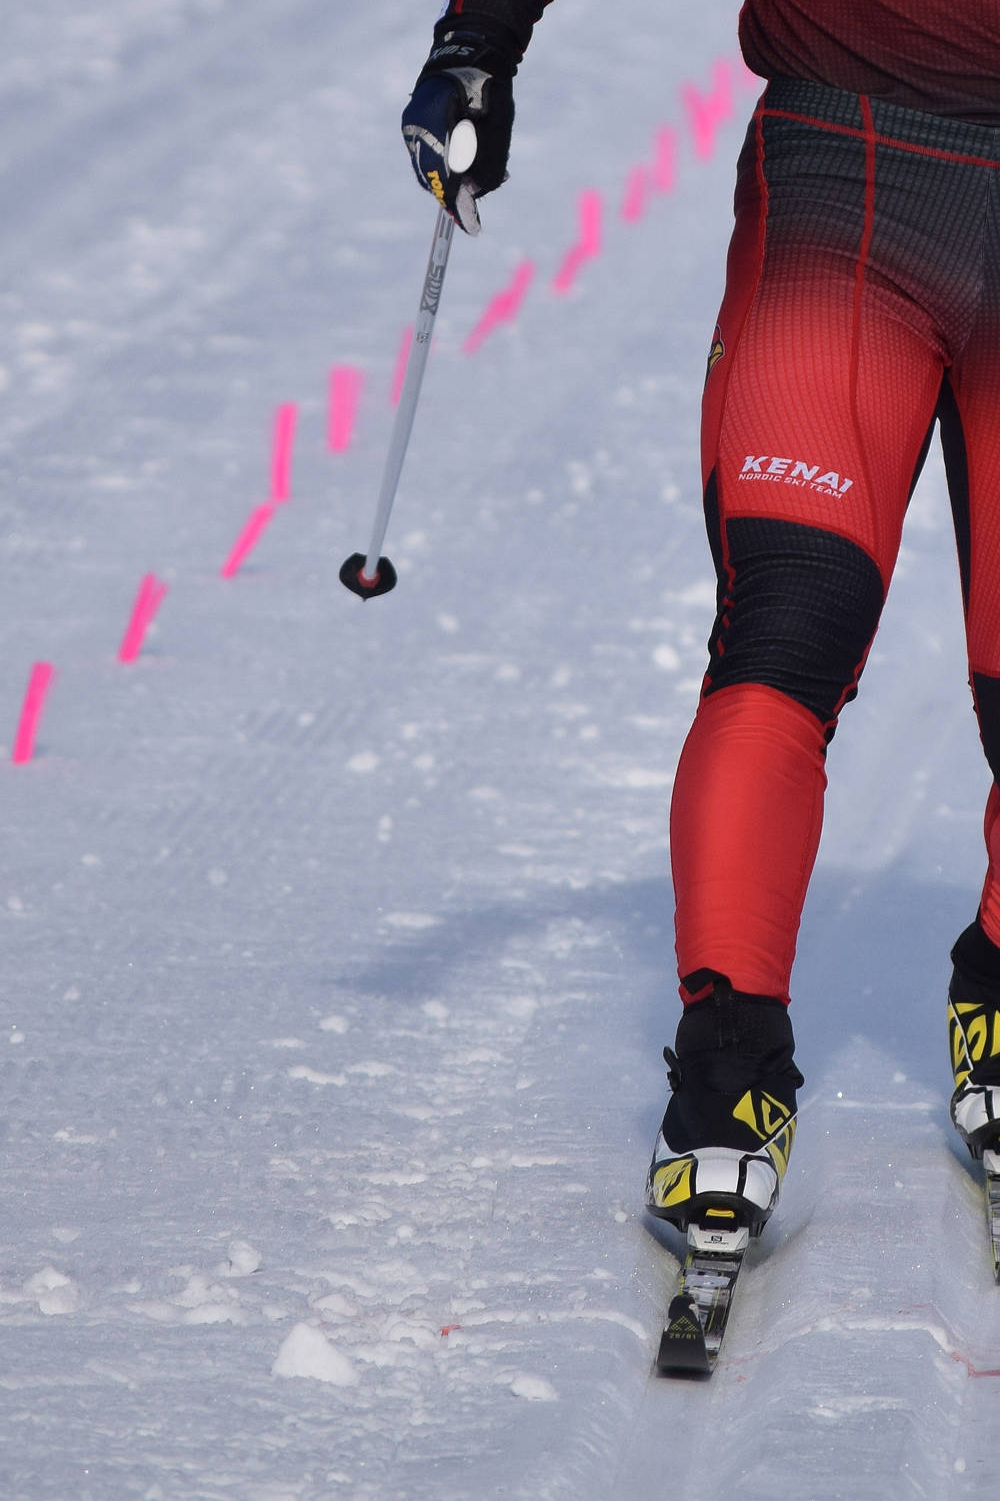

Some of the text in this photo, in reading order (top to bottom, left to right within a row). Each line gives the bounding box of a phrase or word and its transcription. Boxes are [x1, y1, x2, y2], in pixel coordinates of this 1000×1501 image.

[738, 473, 843, 499] NORDIC SKI TEAM
[741, 455, 854, 494] KENAI
